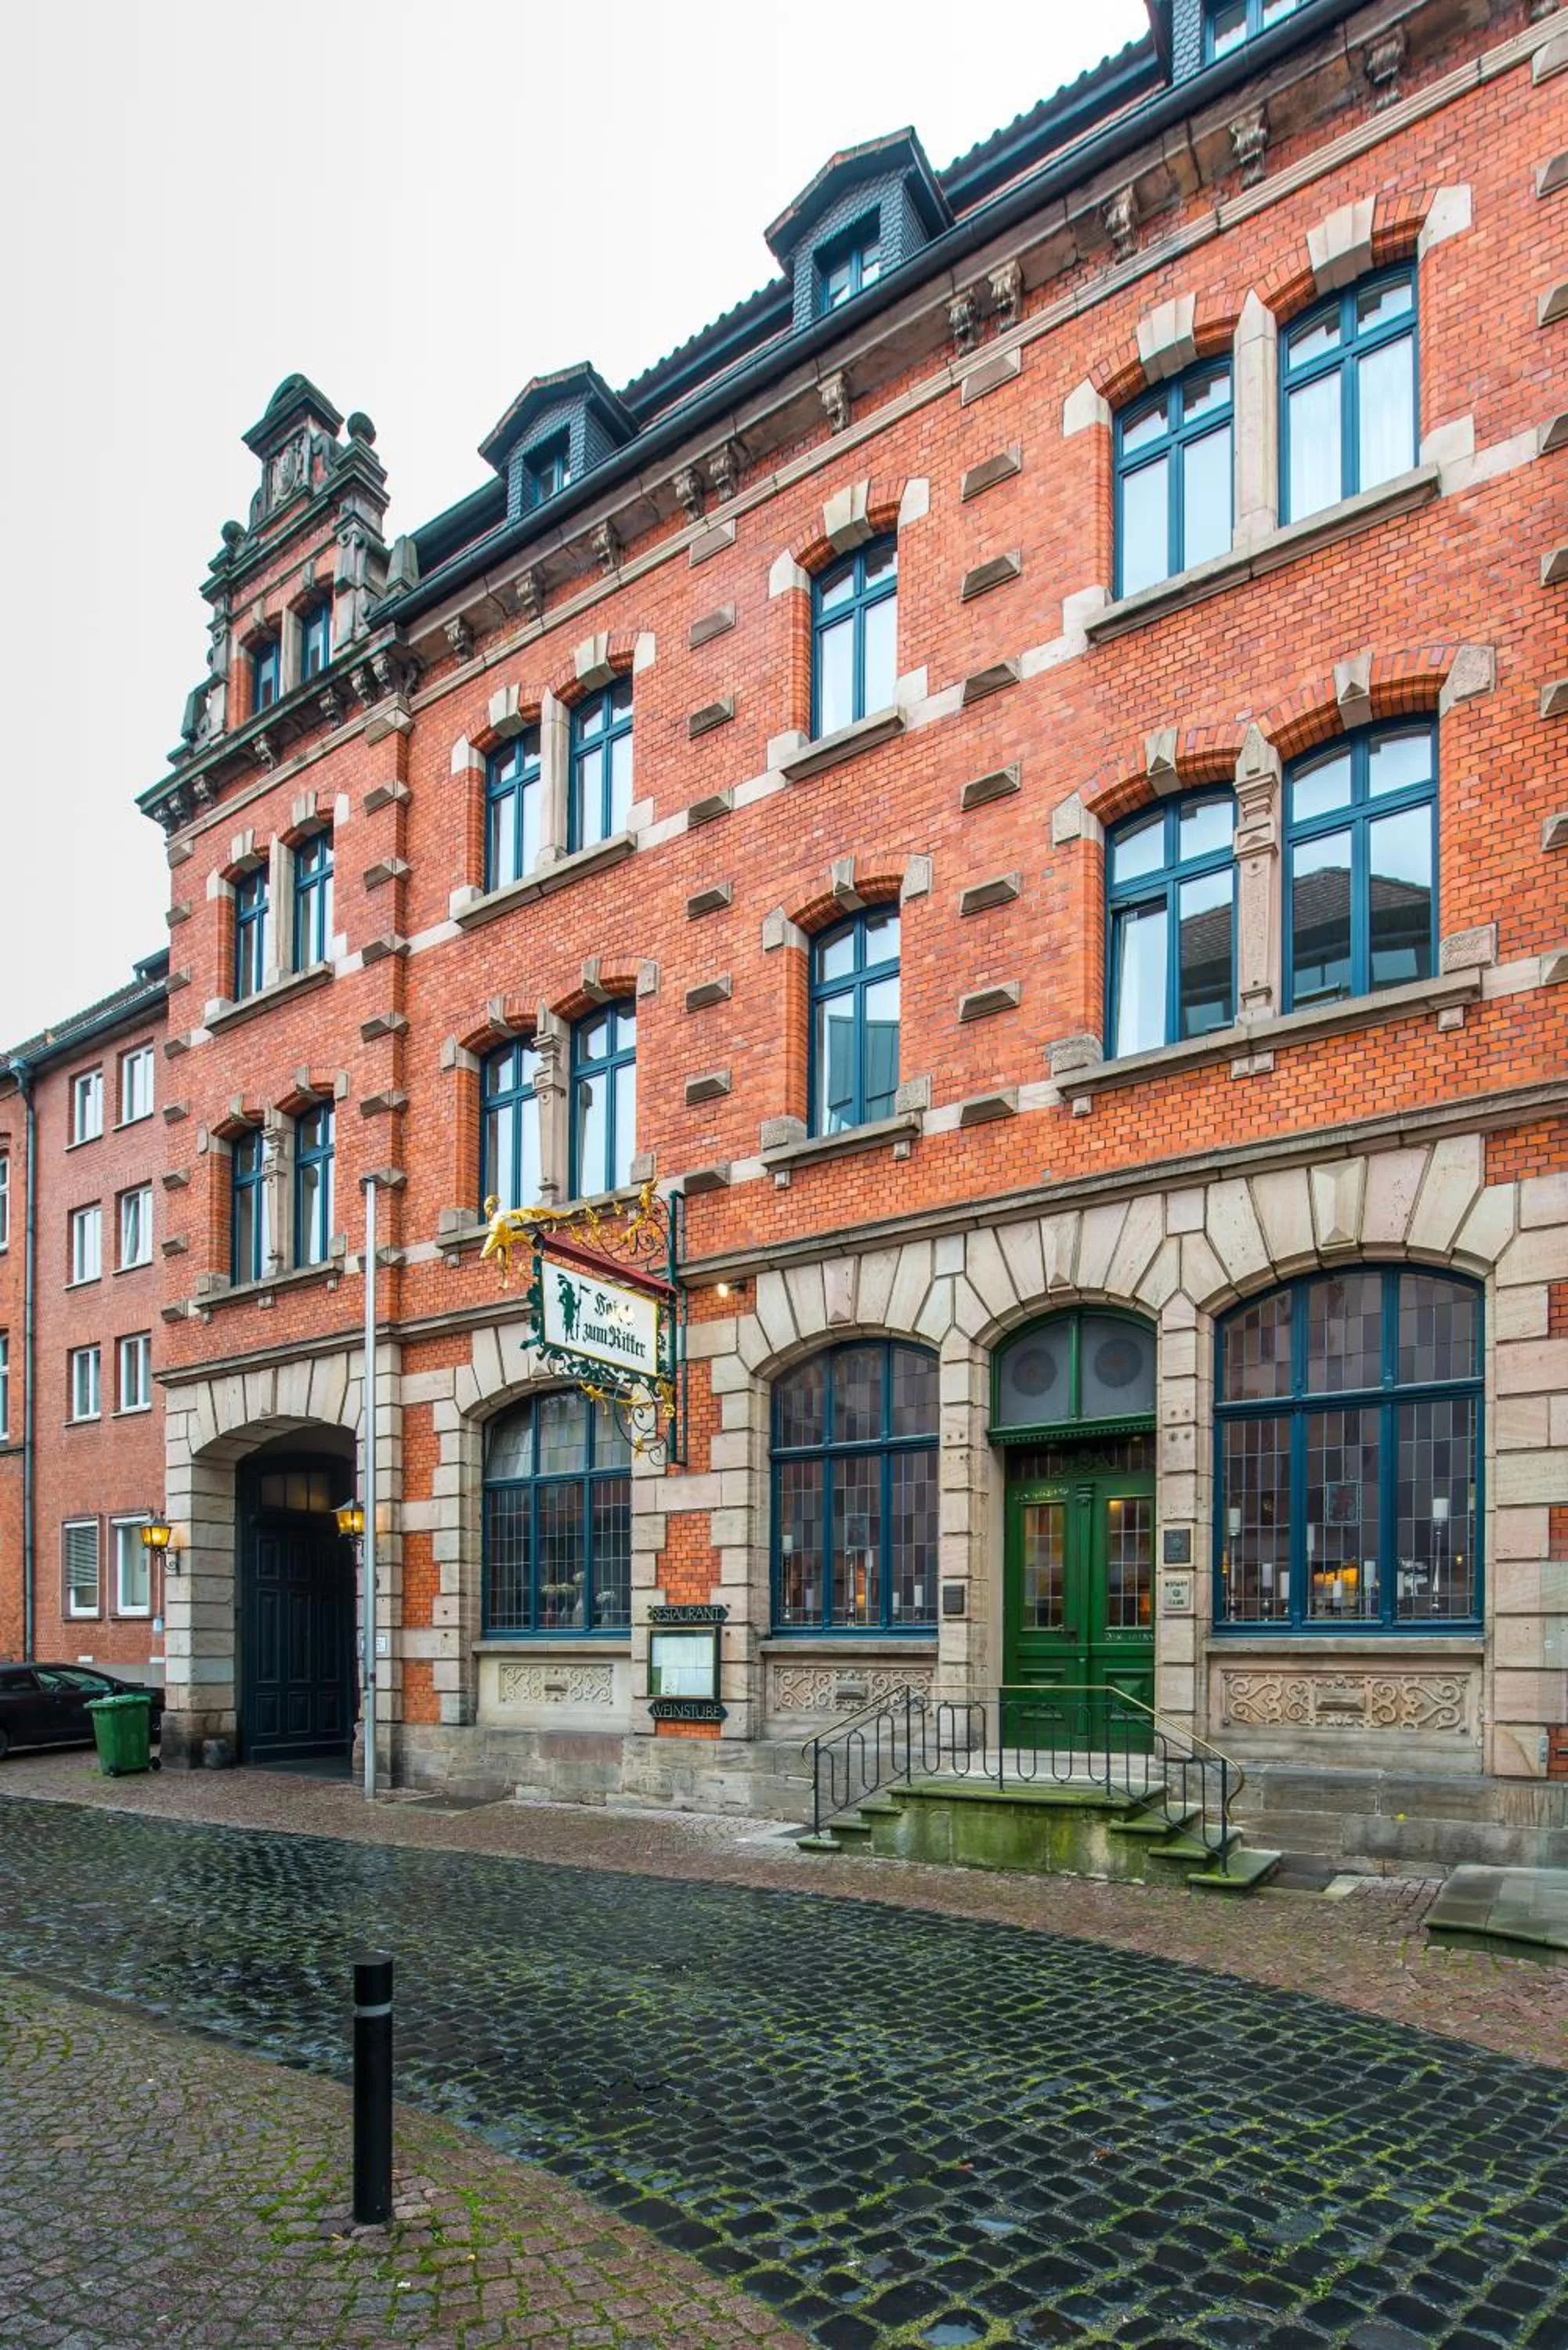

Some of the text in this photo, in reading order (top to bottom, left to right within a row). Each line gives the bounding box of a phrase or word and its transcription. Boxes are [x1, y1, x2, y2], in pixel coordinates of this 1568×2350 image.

[583, 1323, 646, 1358] zum Ritter
[652, 1607, 721, 1622] RESTAURANT
[652, 1704, 721, 1719] WEINSTUBE
